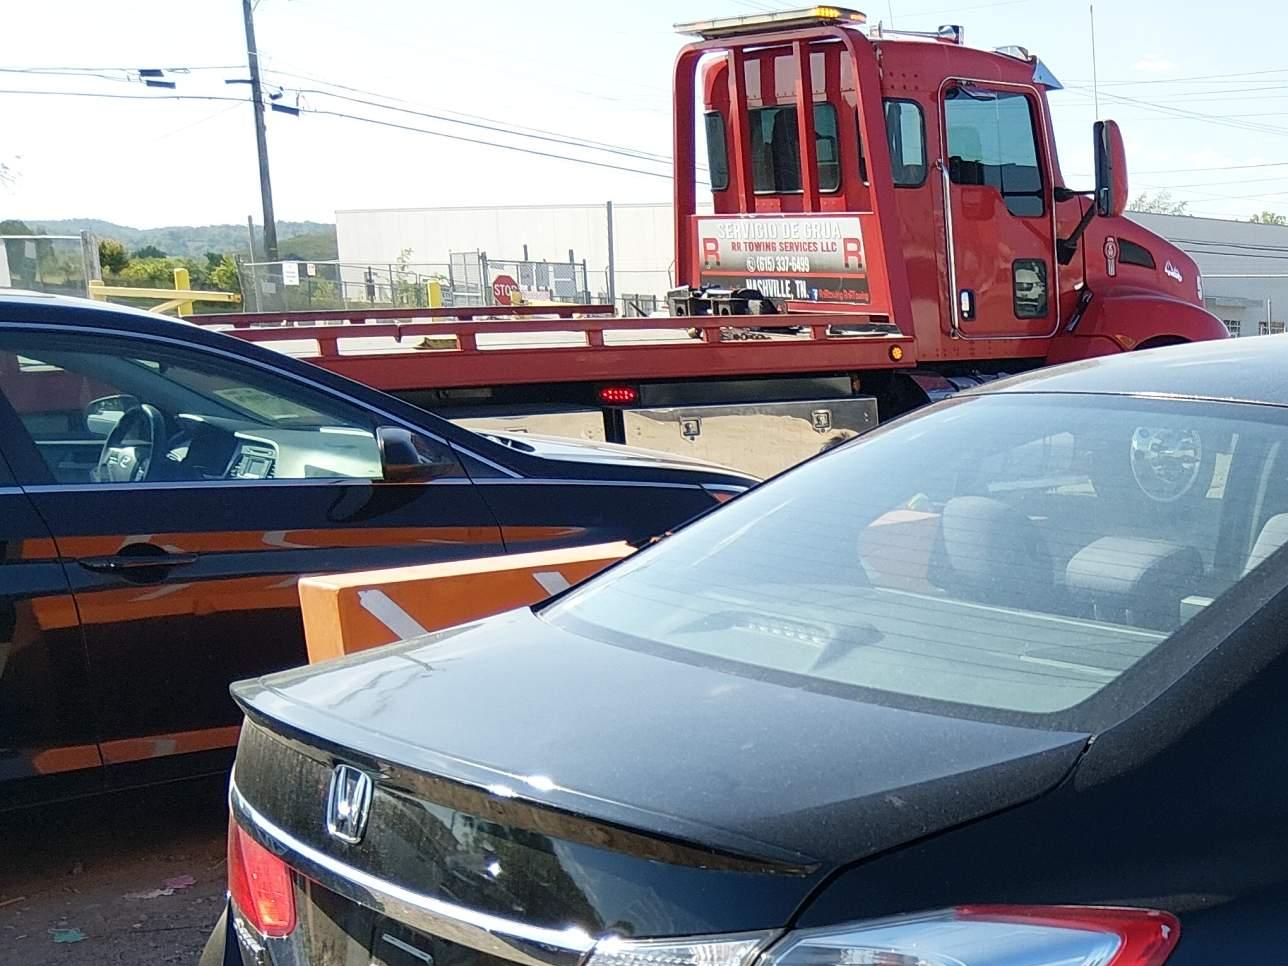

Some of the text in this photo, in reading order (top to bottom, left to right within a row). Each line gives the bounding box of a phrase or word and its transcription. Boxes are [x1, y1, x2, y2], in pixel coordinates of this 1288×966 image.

[718, 221, 842, 240] SERVICIO DE GRUA
[744, 241, 777, 252] TOWING
[779, 241, 818, 253] SERVICES
[821, 241, 838, 253] LLC
[756, 256, 810, 273] (615) 337-6499
[795, 280, 810, 298] TN.
